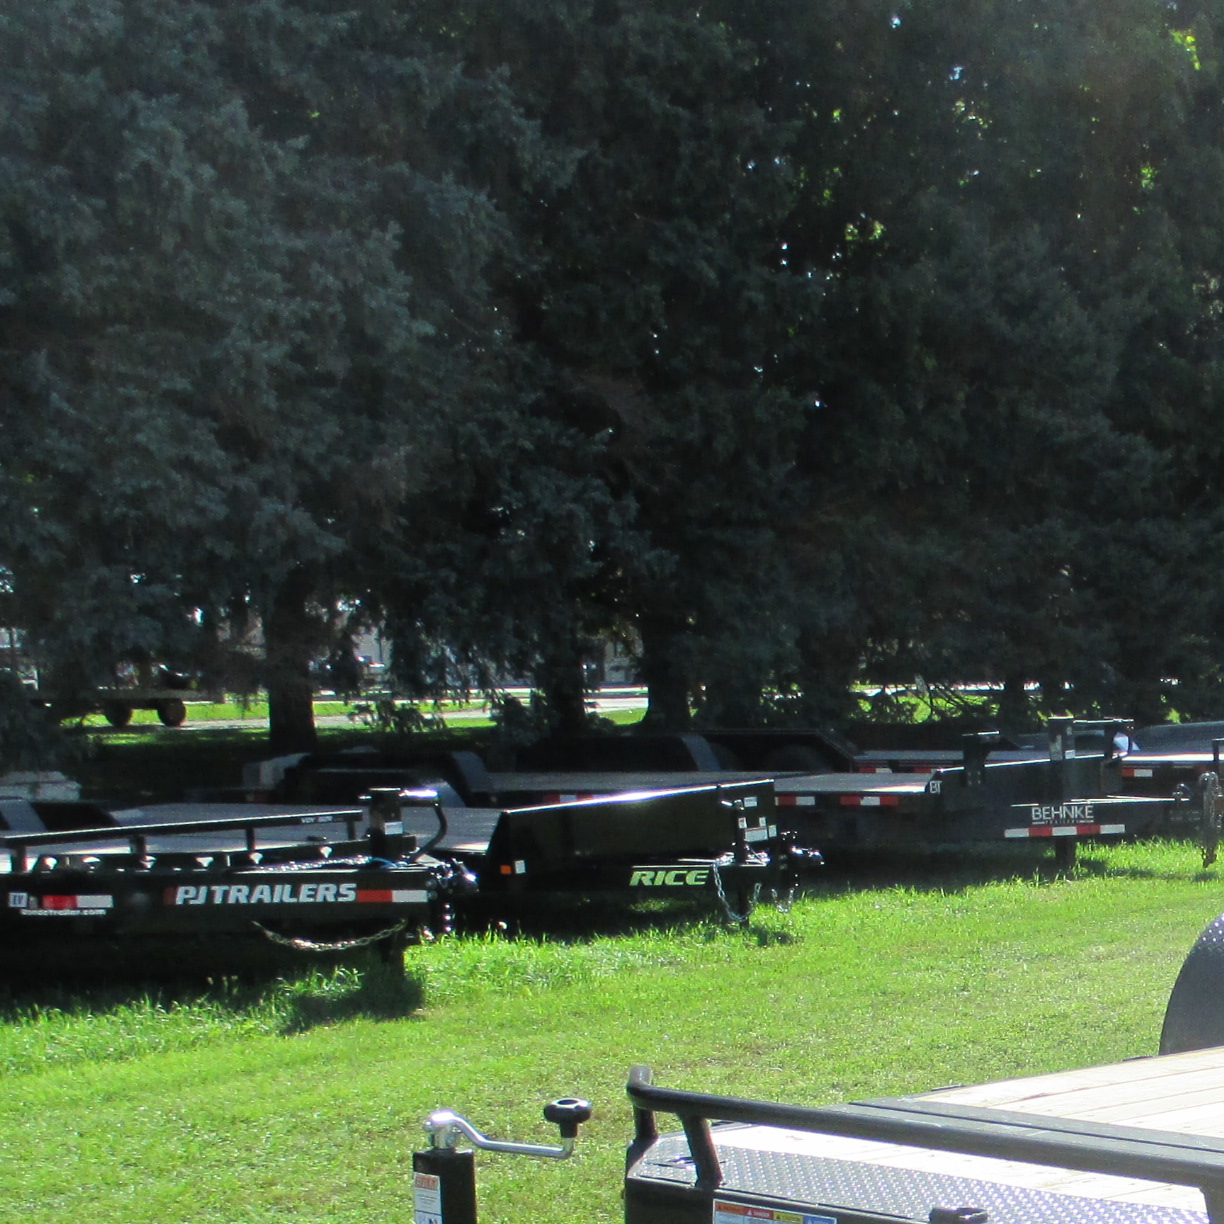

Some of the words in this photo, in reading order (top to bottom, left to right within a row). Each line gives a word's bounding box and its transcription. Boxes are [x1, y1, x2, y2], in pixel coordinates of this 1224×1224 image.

[1031, 805, 1094, 820] BEHNKE
[629, 870, 710, 887] RICE
[175, 886, 208, 905] PJ
[210, 883, 357, 904] TRAILERS
